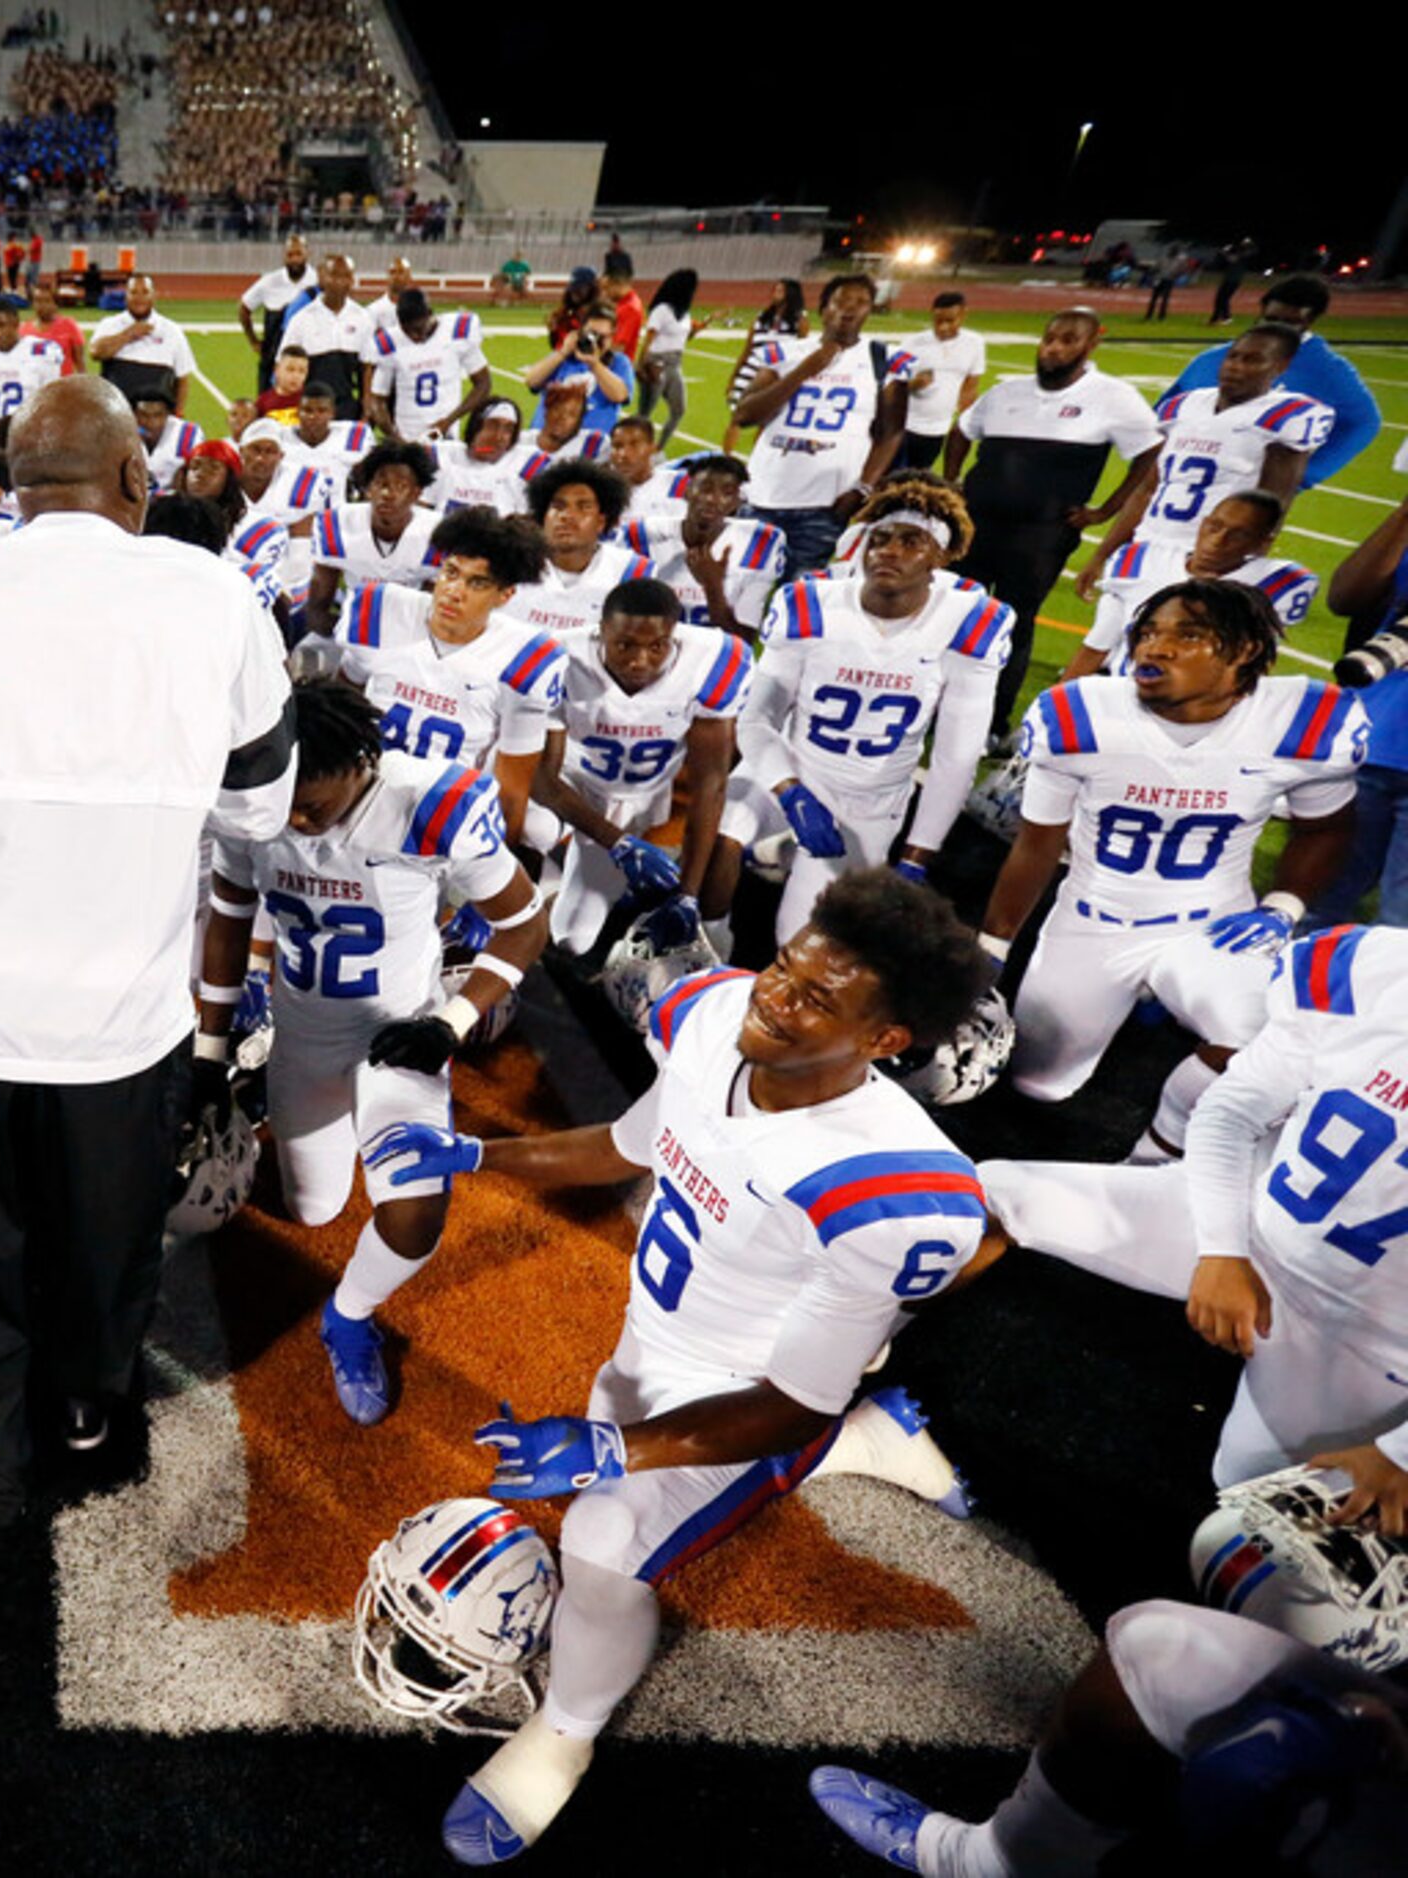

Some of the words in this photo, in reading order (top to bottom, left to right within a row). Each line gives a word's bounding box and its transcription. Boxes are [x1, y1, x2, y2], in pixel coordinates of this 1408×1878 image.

[784, 386, 857, 431] 63
[1149, 454, 1219, 523] 13
[395, 682, 458, 716] PANTHERS
[835, 667, 913, 692] PANTHERS
[596, 721, 664, 737] PANTHERS
[808, 684, 923, 757] 23
[579, 735, 678, 783] 39
[1124, 783, 1229, 810] PANTHERS
[1095, 804, 1246, 881] 80
[276, 869, 363, 901] PANTHERS
[264, 889, 385, 999] 32
[655, 1127, 730, 1224] PANTHERS
[637, 1175, 701, 1313] 6
[891, 1239, 955, 1297] 6
